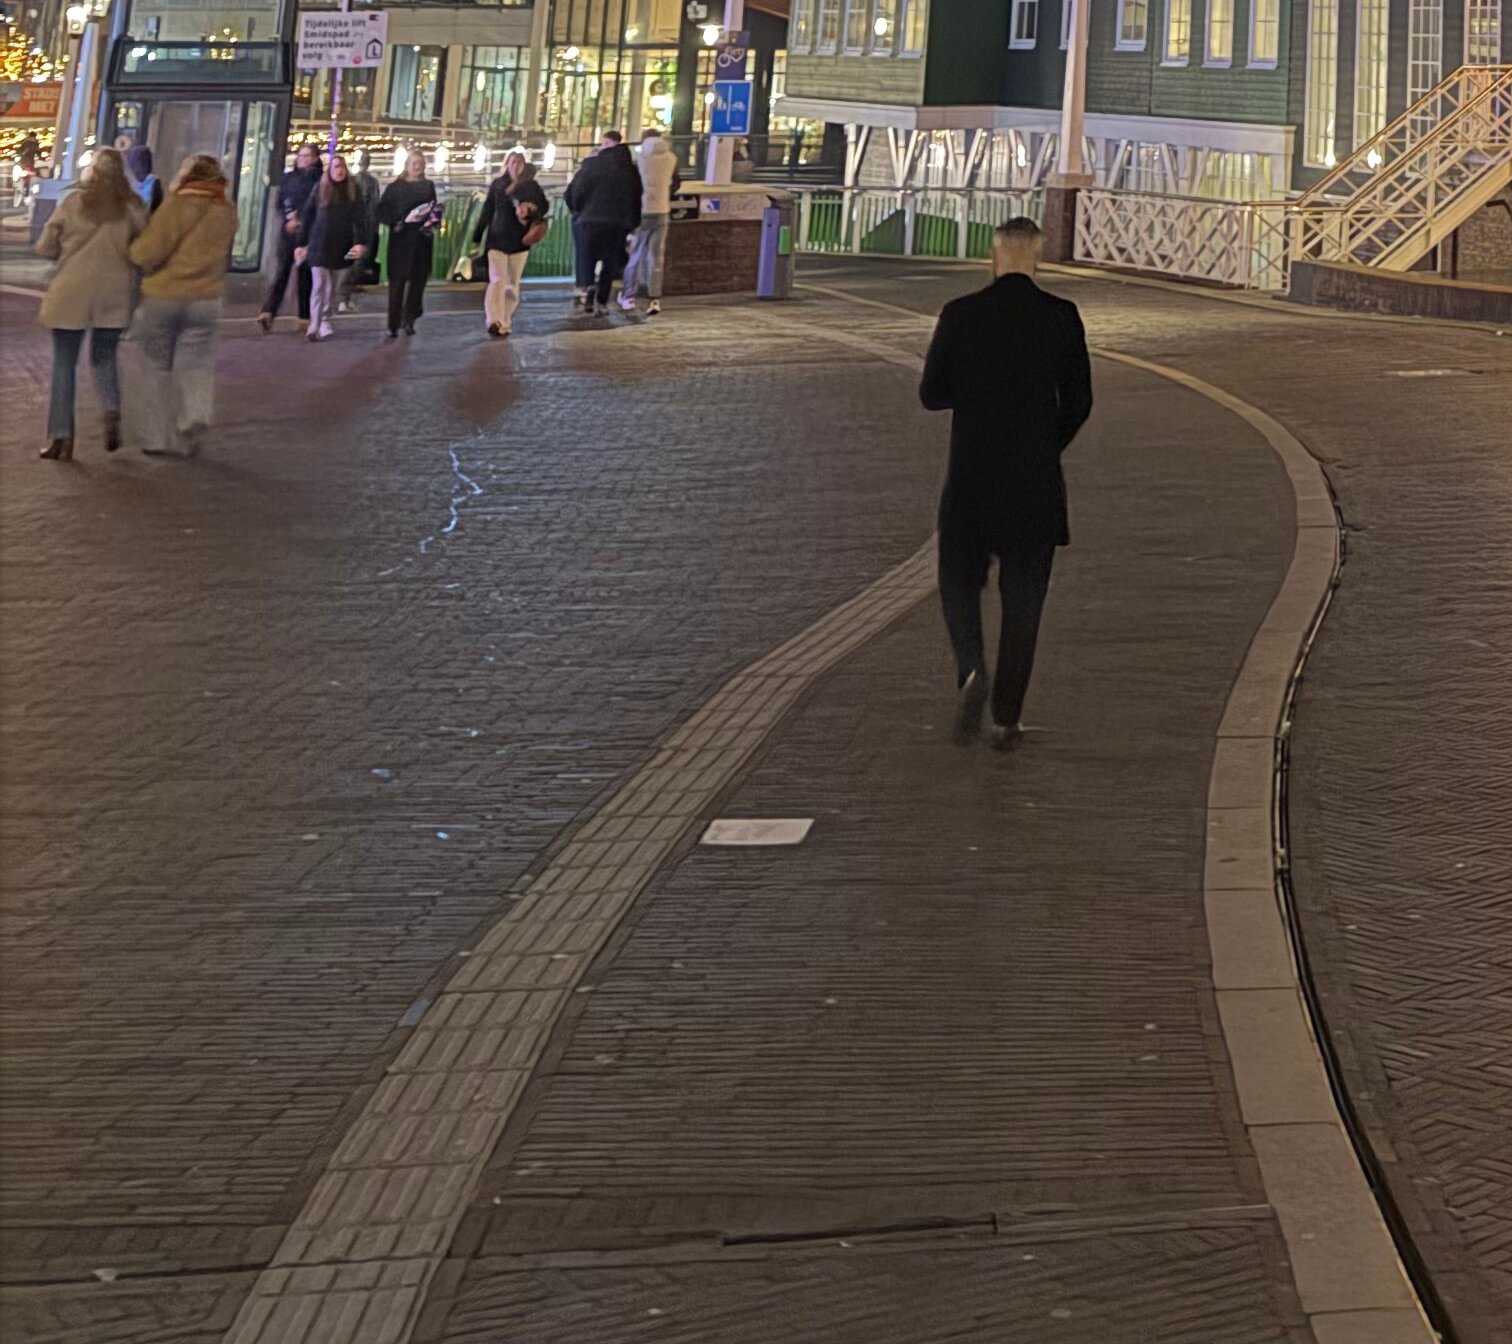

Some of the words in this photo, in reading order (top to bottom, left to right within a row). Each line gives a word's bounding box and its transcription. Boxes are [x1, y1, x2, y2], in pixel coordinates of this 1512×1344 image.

[304, 19, 349, 29] Tijdelijke
[351, 19, 366, 28] lift
[303, 41, 355, 49] bereikbaar
[302, 52, 323, 61] volg
